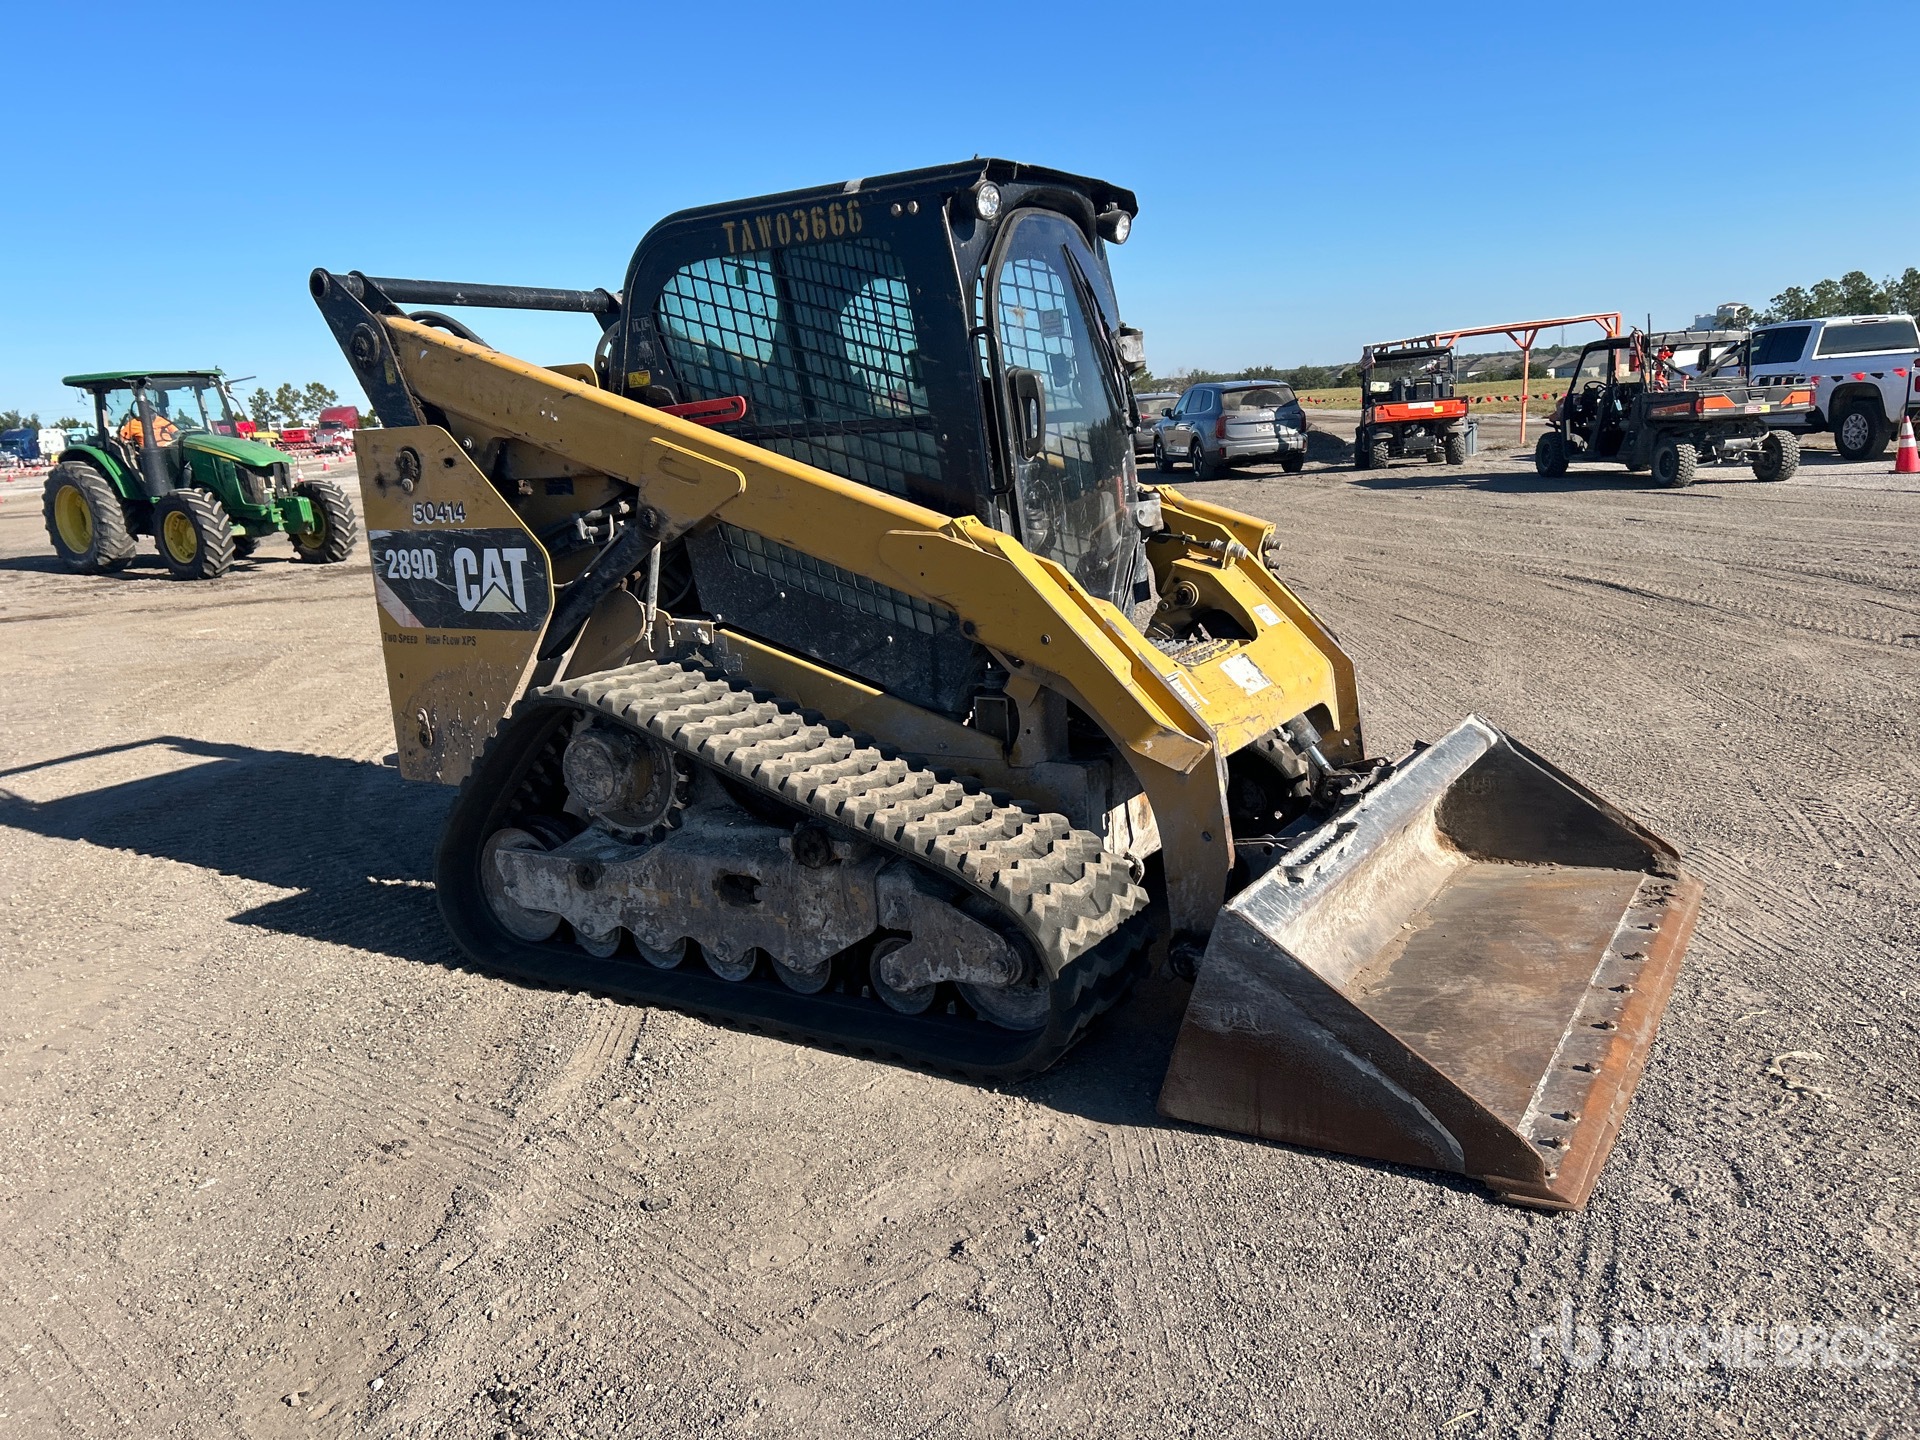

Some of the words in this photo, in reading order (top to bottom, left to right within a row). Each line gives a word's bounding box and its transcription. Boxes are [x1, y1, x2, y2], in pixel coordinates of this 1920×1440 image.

[722, 200, 862, 253] TAW03666
[412, 501, 467, 524] 50414
[385, 549, 438, 580] 289D
[453, 547, 528, 613] CAT
[461, 635, 477, 647] XPS
